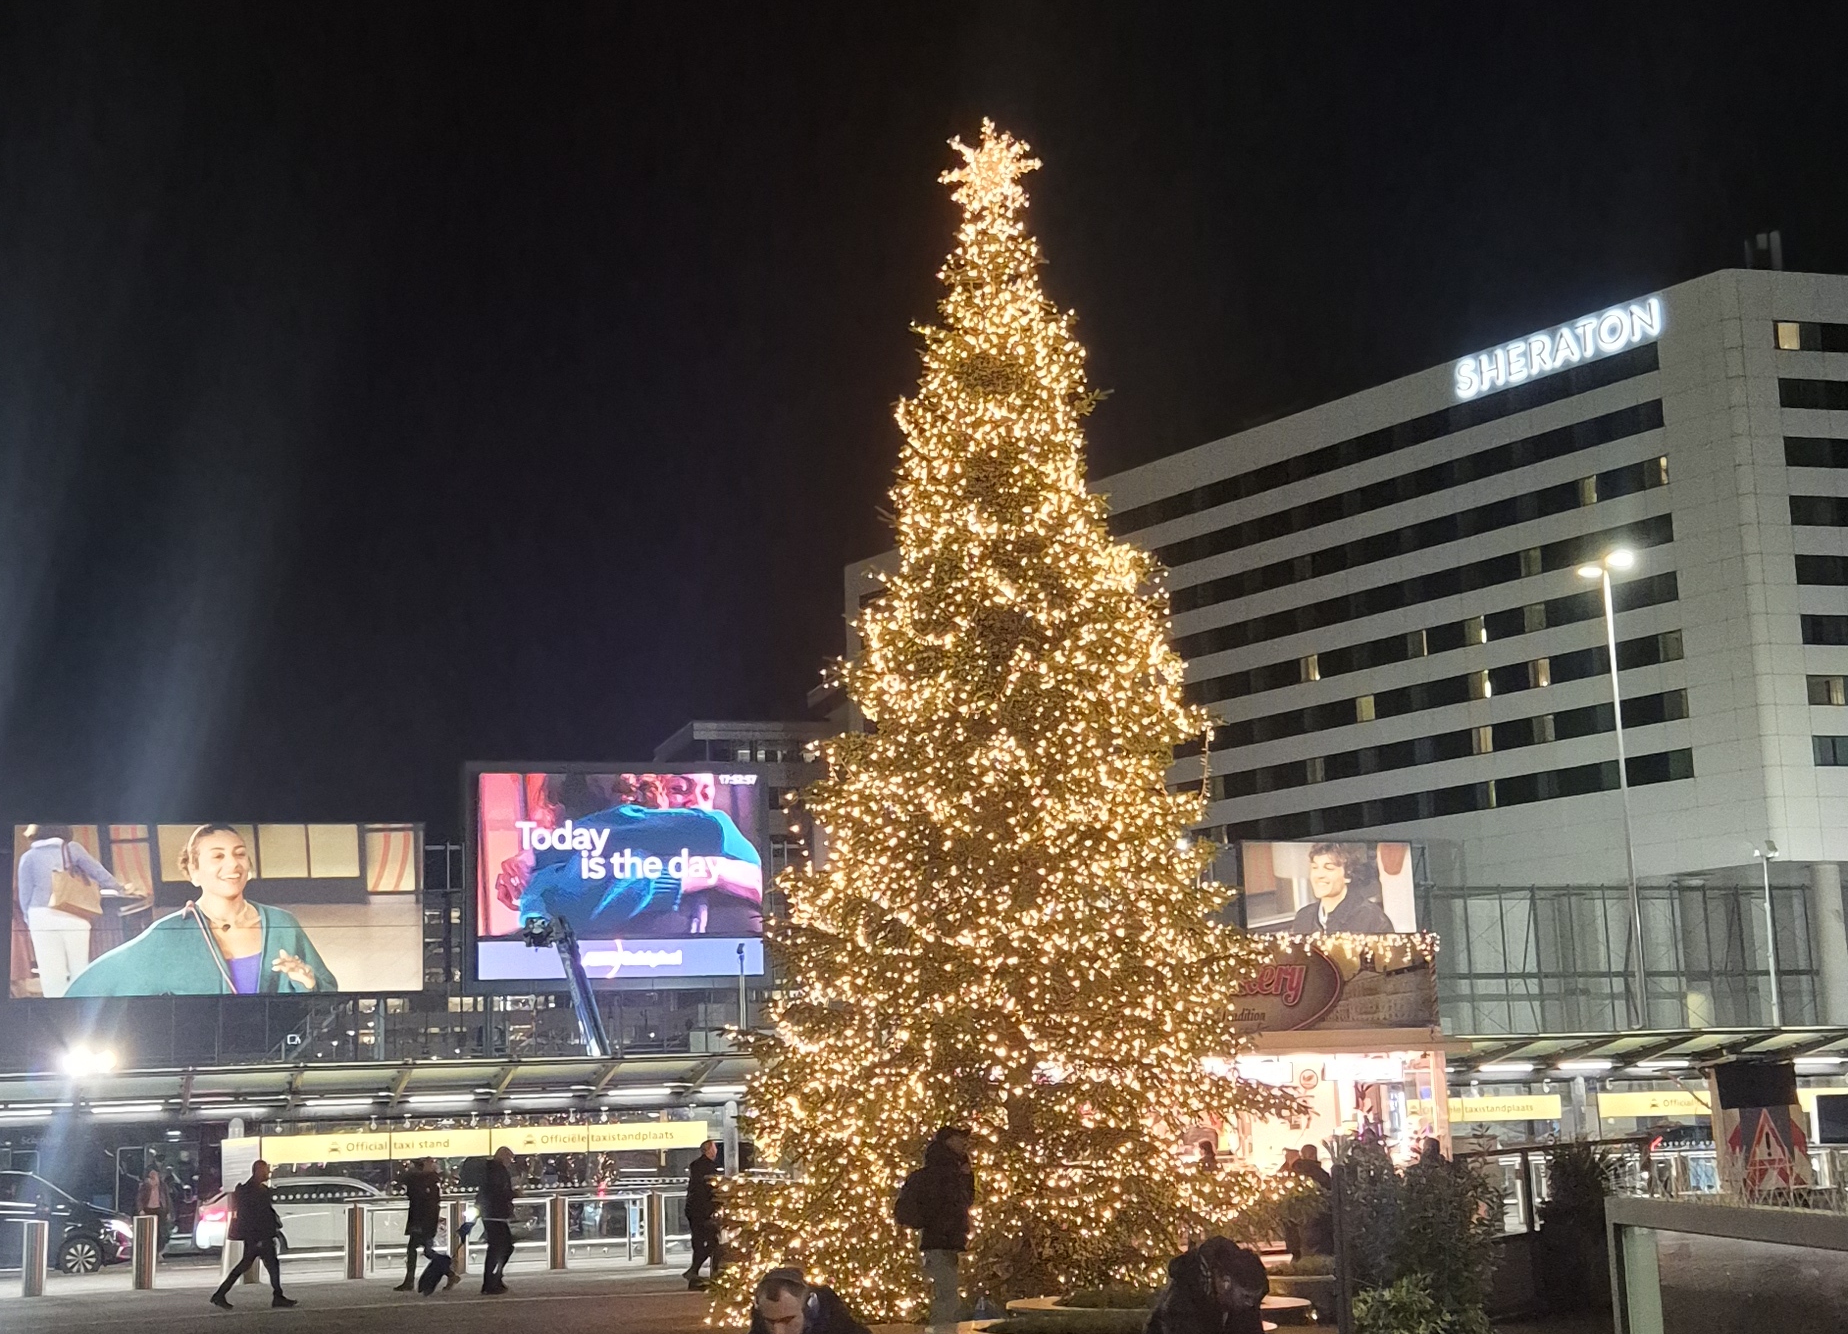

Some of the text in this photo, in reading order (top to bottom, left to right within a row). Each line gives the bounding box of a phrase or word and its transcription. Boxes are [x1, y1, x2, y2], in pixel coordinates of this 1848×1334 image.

[1455, 298, 1661, 399] SHERATON
[515, 820, 610, 856] Today
[581, 848, 723, 883] is the day
[1465, 1103, 1534, 1114] taxistandplaats
[346, 1139, 450, 1152] Official taxi stand
[541, 1131, 674, 1143] Officiële taxistandplaats
